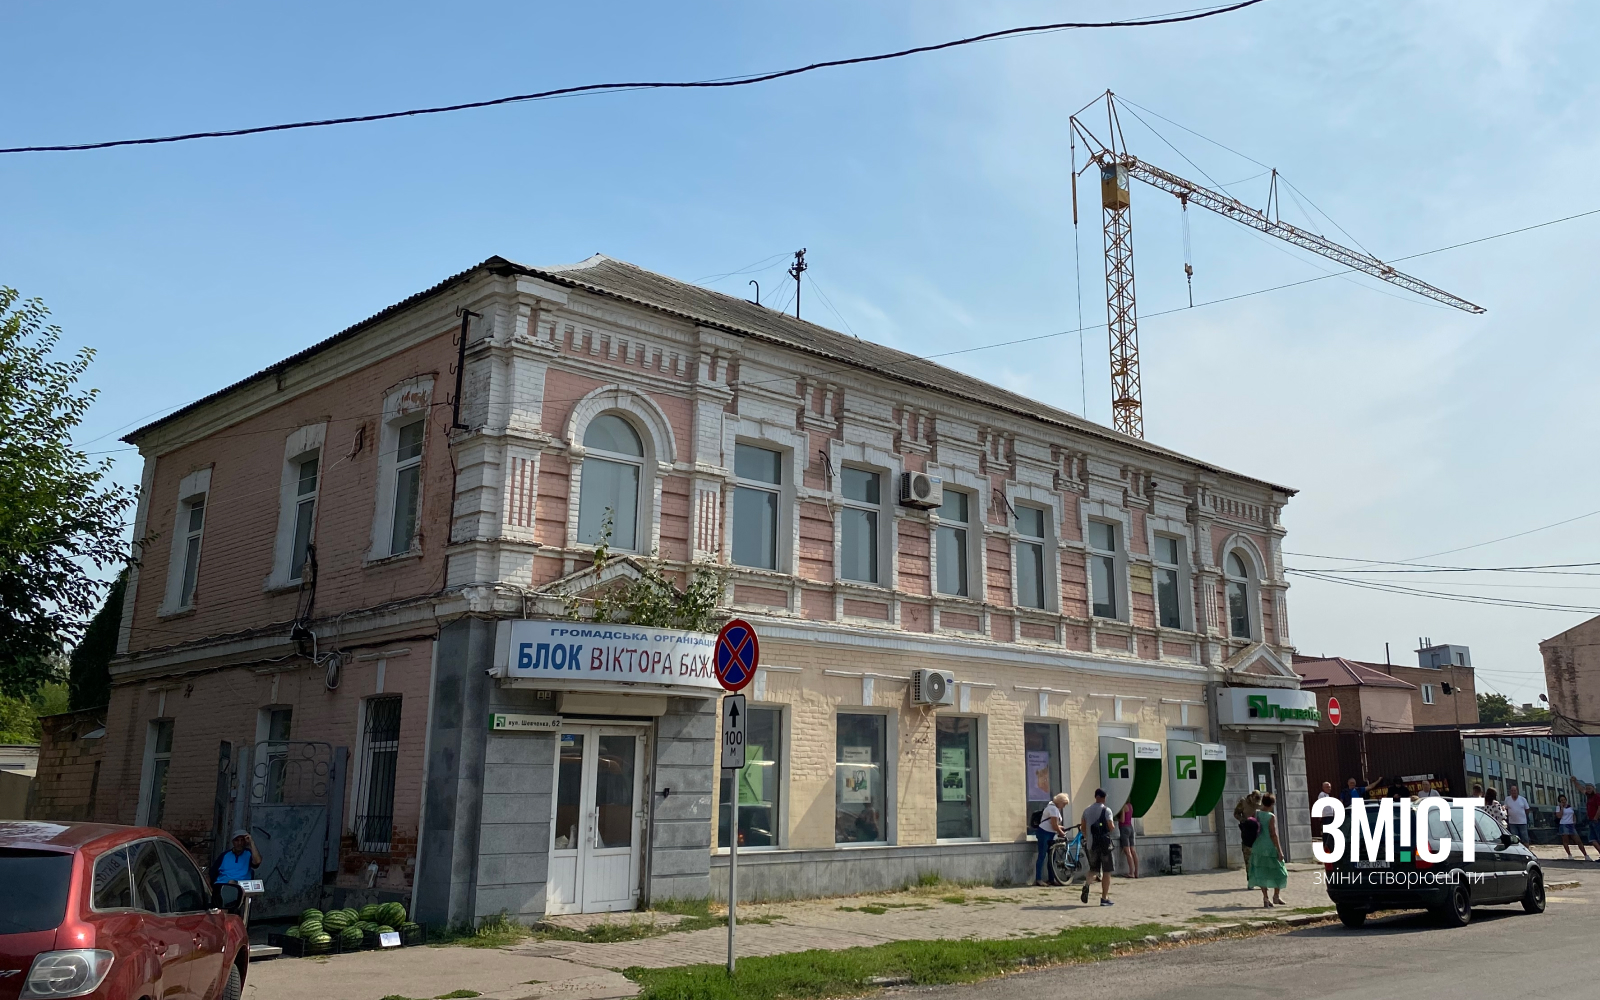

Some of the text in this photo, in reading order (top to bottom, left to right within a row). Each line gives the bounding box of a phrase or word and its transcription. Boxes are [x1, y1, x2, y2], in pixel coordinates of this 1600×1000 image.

[551, 628, 648, 641] ГРОМАДСЬКА
[518, 642, 583, 671] БЛОК
[590, 646, 673, 675] ВІКТОРА
[725, 731, 743, 745] 100
